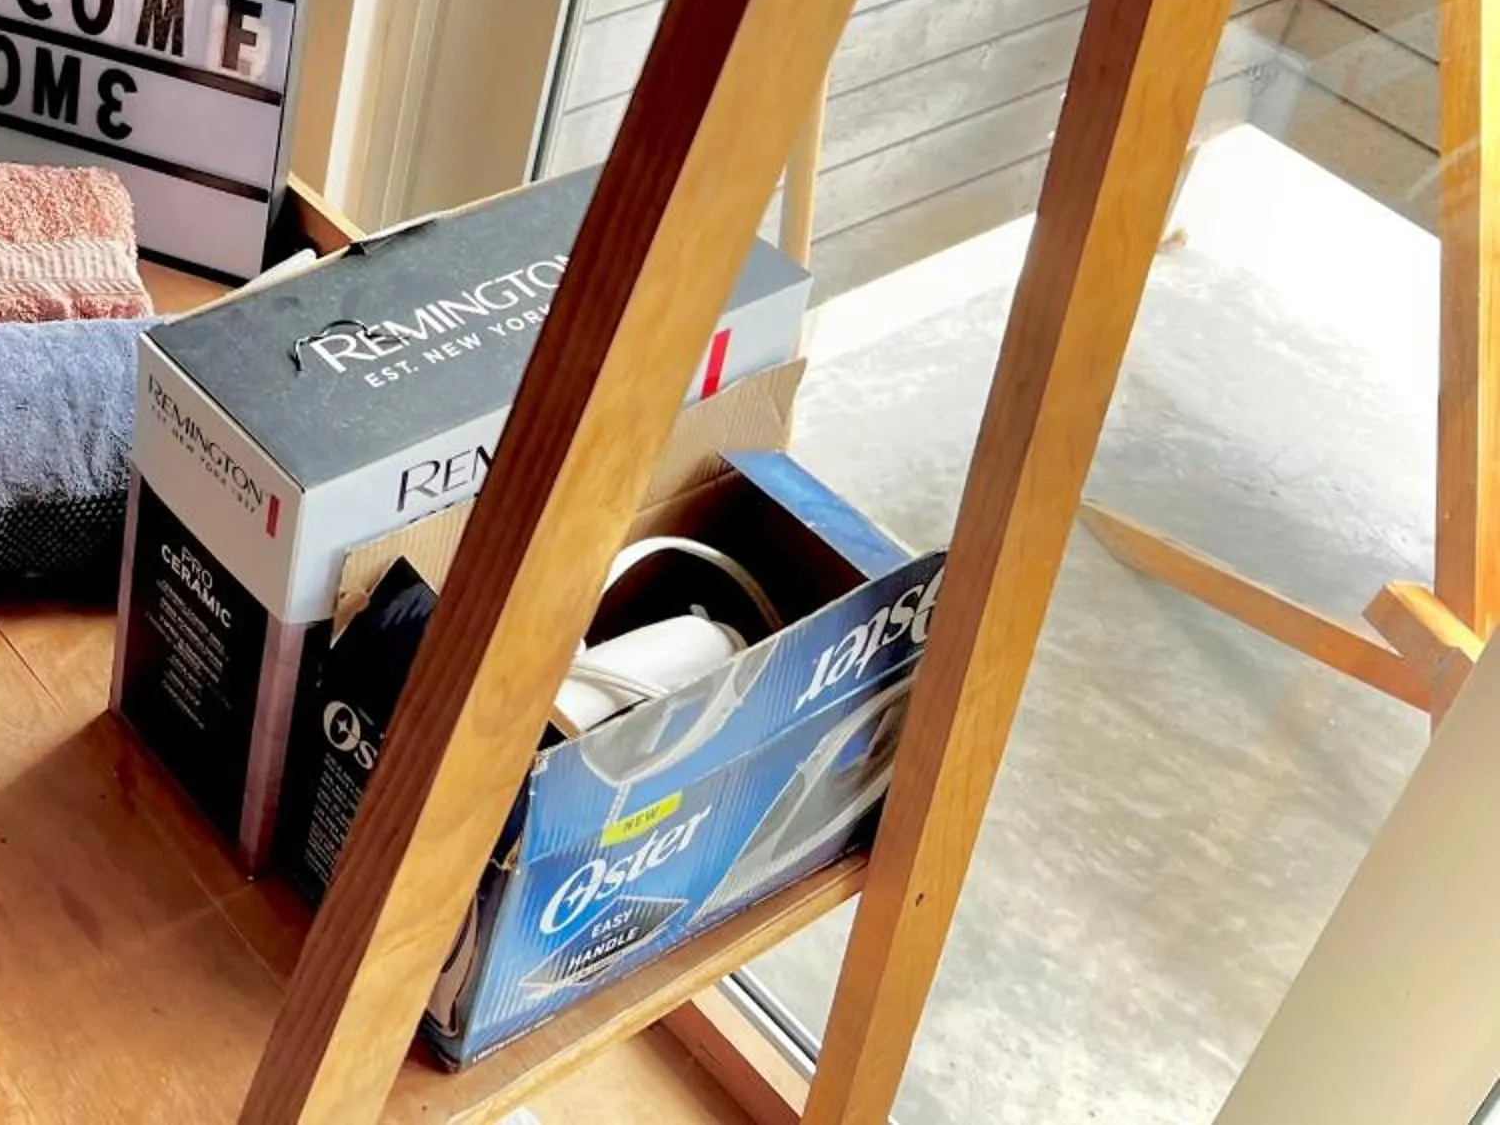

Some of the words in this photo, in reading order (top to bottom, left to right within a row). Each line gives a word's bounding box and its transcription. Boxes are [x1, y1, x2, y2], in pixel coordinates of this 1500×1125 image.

[309, 254, 570, 373] REMINGTO
[364, 359, 419, 388] EST.
[422, 332, 482, 365] NEW
[148, 373, 264, 507] REMINGTON
[161, 543, 233, 629] CERAMIC
[181, 545, 213, 591] PRO
[539, 803, 712, 935] Oster
[567, 925, 641, 972] HANDLE
[591, 907, 634, 938] EASY
